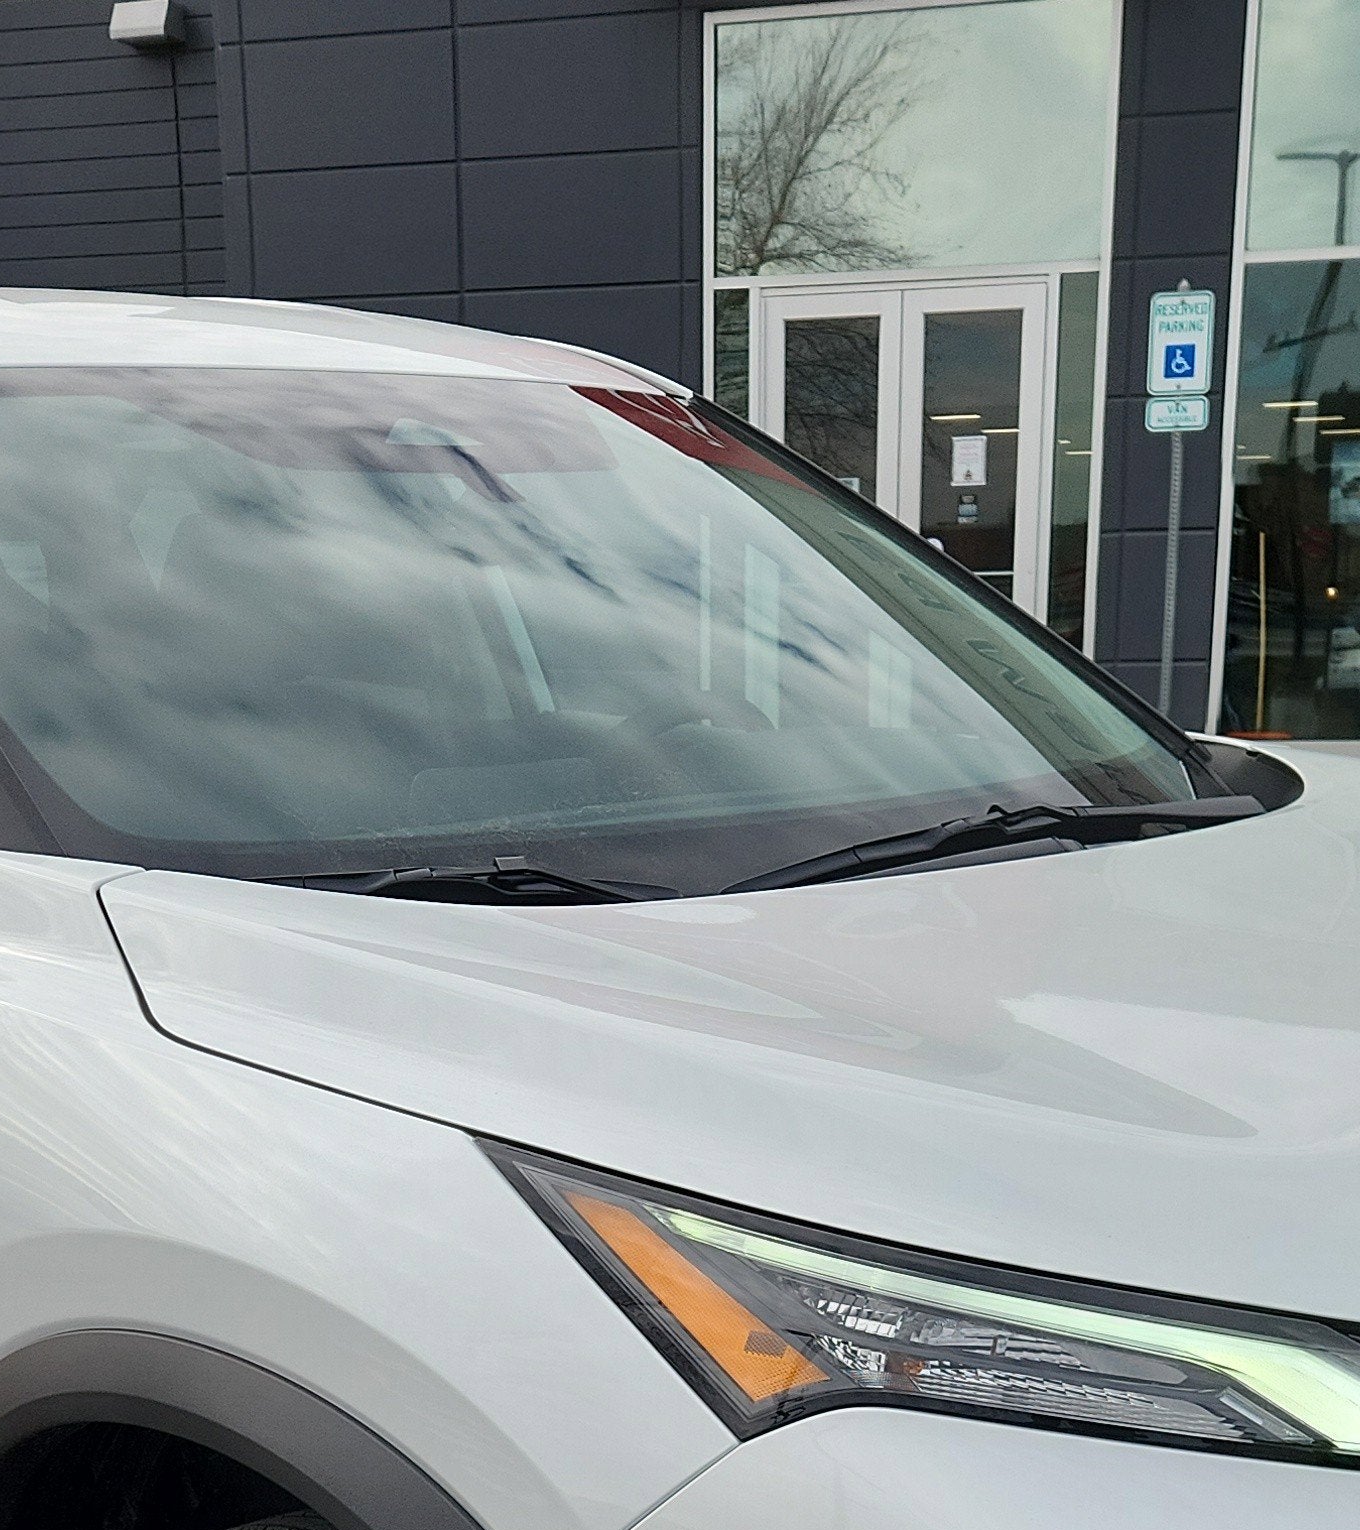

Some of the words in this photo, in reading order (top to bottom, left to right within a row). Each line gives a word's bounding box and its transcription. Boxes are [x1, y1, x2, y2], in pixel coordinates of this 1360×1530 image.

[1155, 303, 1208, 316] RESERVED
[1159, 319, 1204, 333] PARKING
[1167, 405, 1188, 415] VAN
